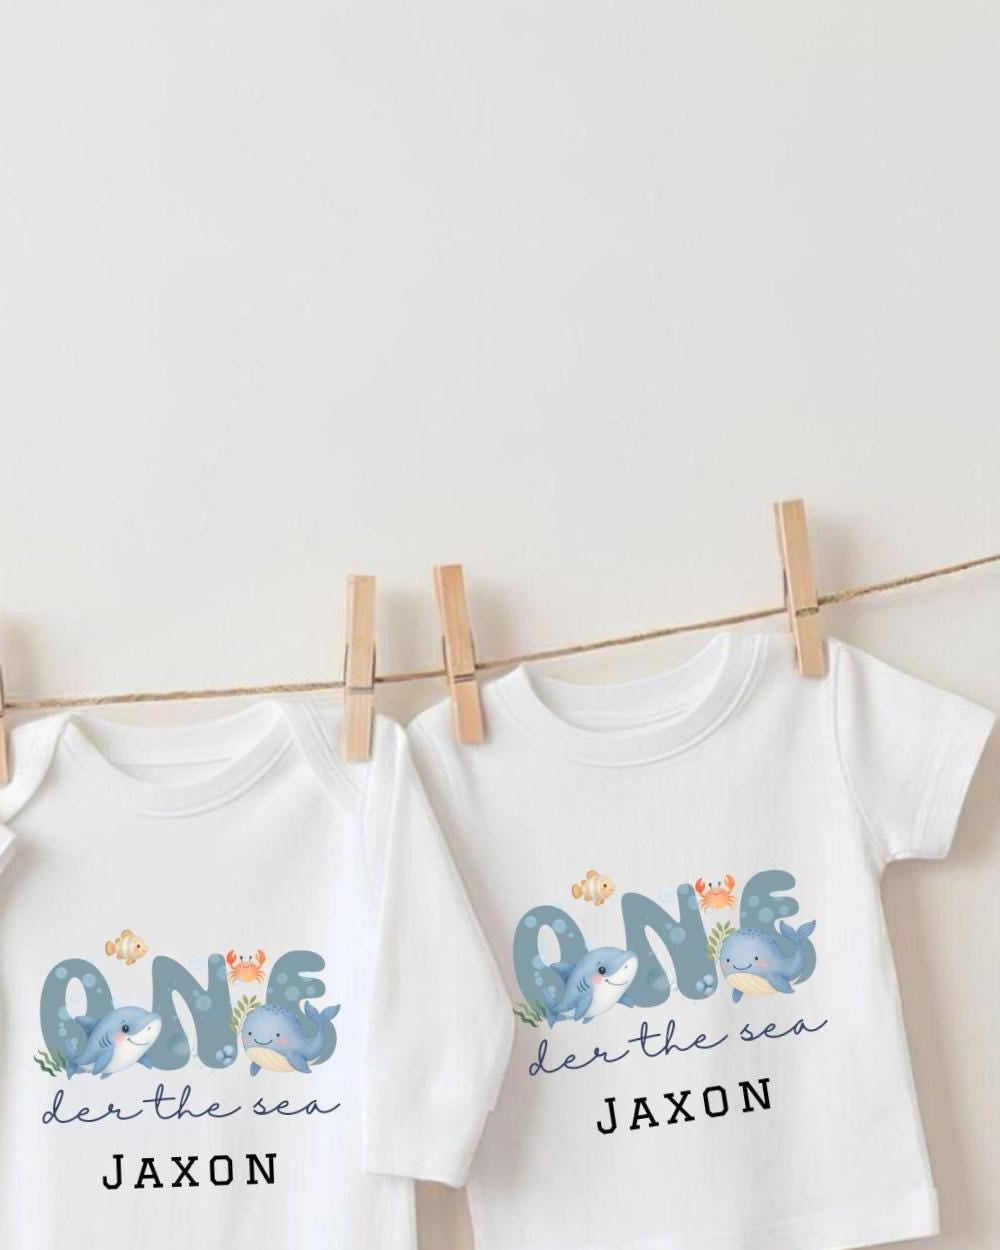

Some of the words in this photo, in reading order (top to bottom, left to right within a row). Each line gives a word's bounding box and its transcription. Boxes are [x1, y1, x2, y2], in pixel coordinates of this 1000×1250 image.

[512, 869, 817, 1021] ONE
[39, 949, 338, 1073] ONE
[528, 1039, 630, 1077] der
[627, 1019, 729, 1058] the
[739, 1018, 828, 1042] sea
[41, 1089, 143, 1125] der
[142, 1083, 242, 1120] the
[252, 1097, 341, 1117] sea
[596, 1077, 772, 1135] JAXON
[102, 1153, 277, 1190] JAXON
